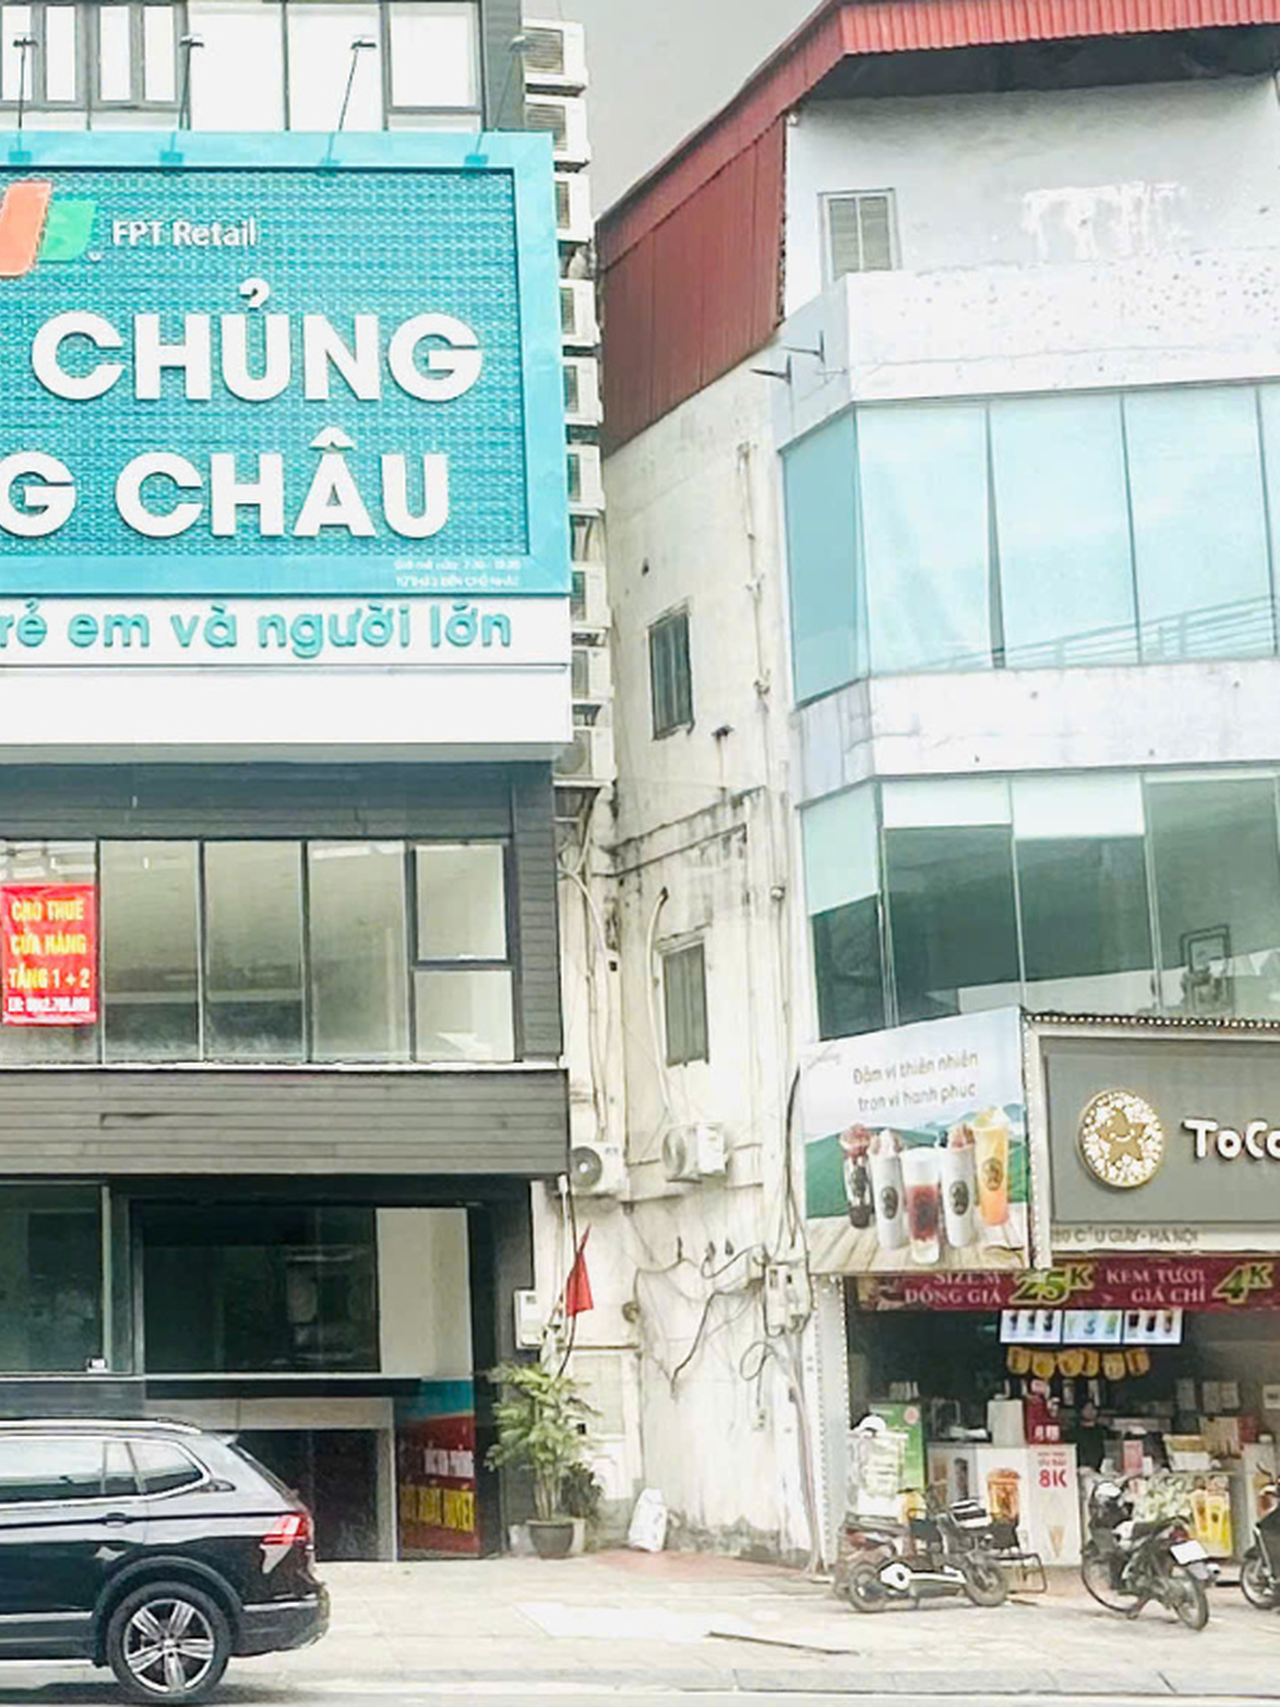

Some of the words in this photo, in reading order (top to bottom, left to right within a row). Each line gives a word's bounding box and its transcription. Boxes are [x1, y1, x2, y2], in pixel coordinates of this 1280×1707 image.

[113, 221, 164, 246] FPT
[172, 217, 256, 246] Retail
[32, 278, 483, 402] CHỦNG
[116, 426, 450, 538] CHÂU
[67, 613, 150, 648] em
[170, 604, 237, 648] và
[257, 604, 410, 658] người
[430, 603, 511, 648] lớn
[52, 968, 60, 988] 1
[79, 968, 90, 988] 2
[1107, 1269, 1150, 1284] KEM
[1212, 1263, 1273, 1304] 4K
[1039, 1469, 1067, 1488] 8K
